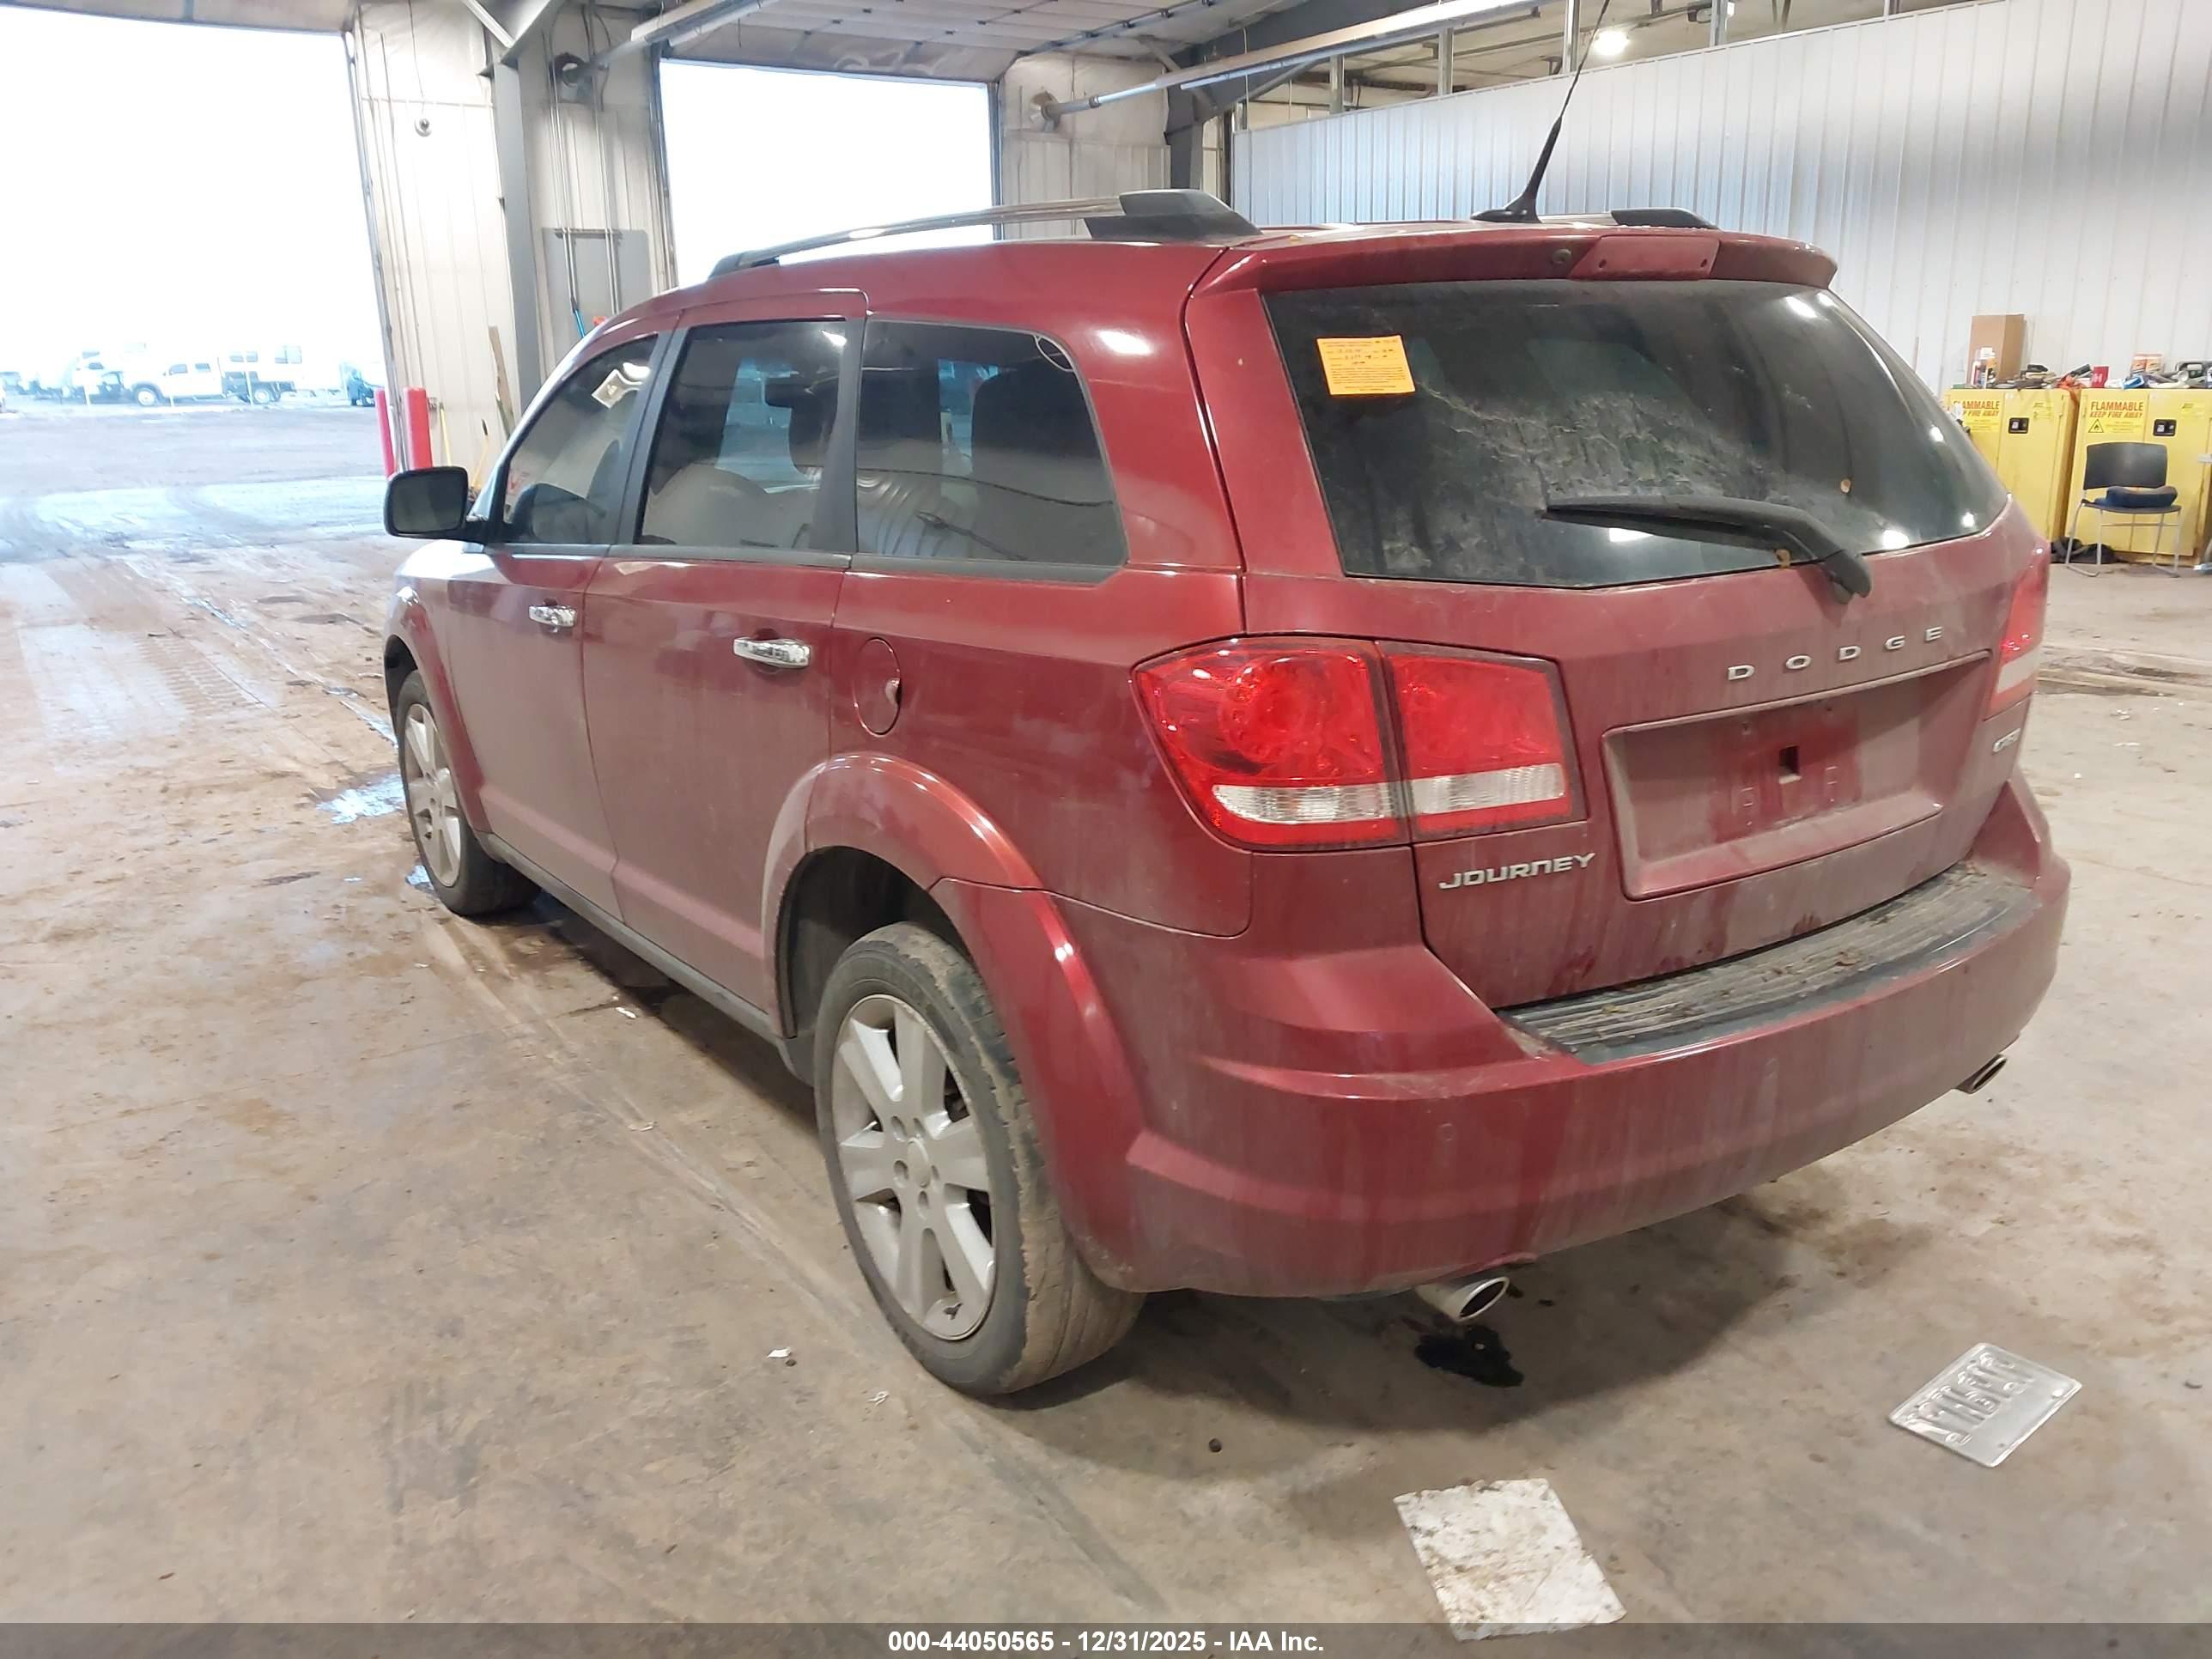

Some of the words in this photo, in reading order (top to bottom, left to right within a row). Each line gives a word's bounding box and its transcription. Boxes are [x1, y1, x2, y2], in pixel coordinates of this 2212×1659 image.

[1954, 400, 2000, 410] AMMABLE
[2090, 401, 2144, 411] FLAMMABLE
[1728, 626, 1943, 680] DODGE
[1438, 853, 1595, 890] JOURNEY
